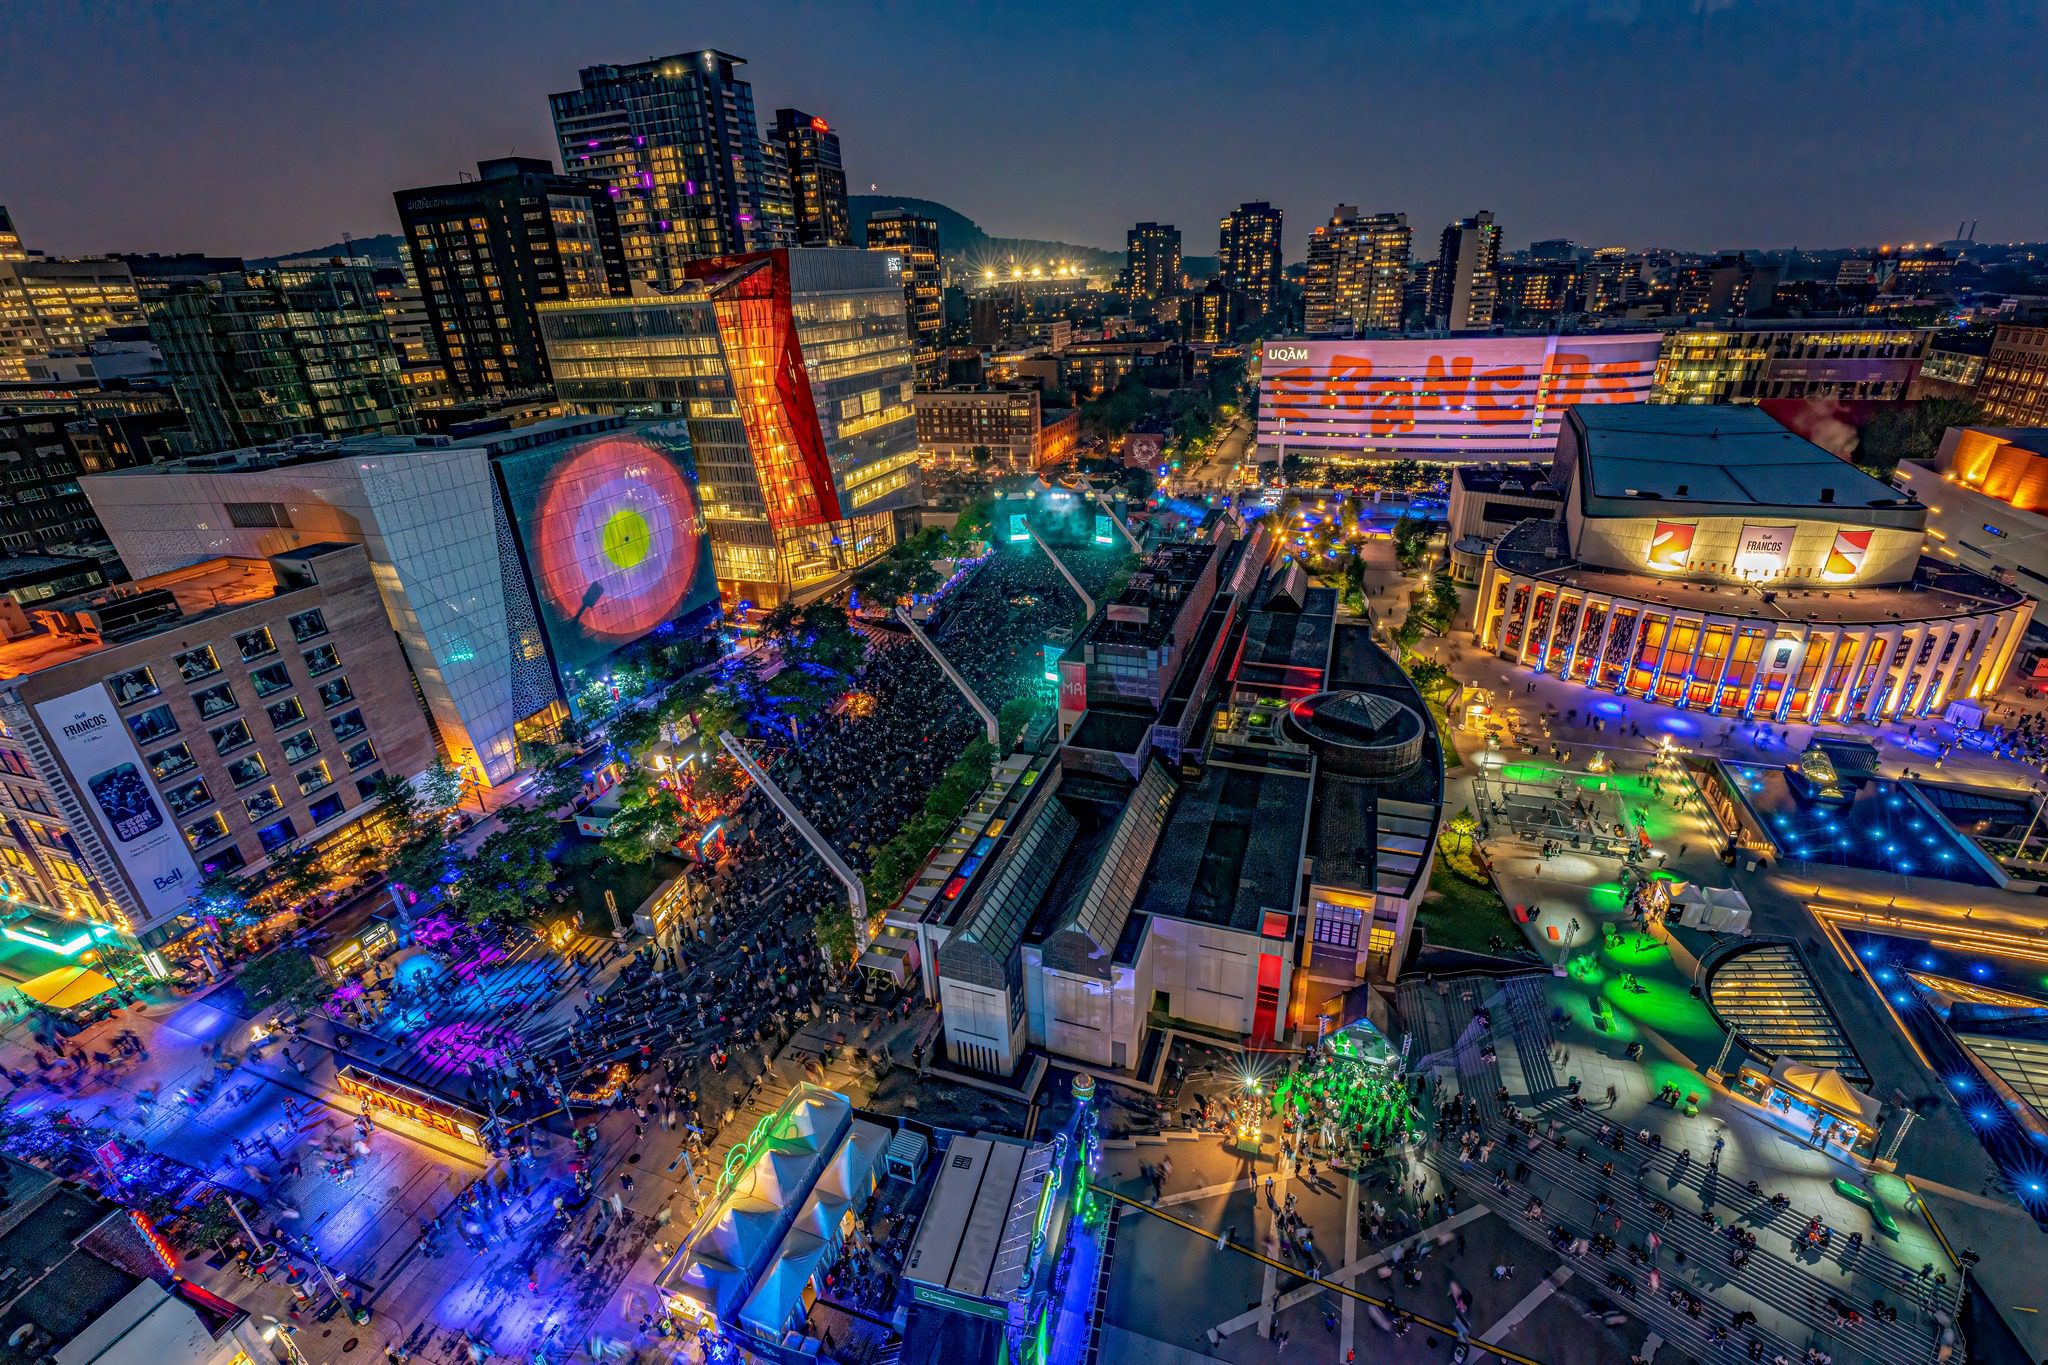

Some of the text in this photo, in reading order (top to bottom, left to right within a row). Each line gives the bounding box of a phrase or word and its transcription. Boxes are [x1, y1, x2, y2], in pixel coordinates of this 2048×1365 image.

[1746, 541, 1783, 551] FRANCOS
[63, 713, 107, 737] FRANCOS
[153, 867, 184, 890] Bell
